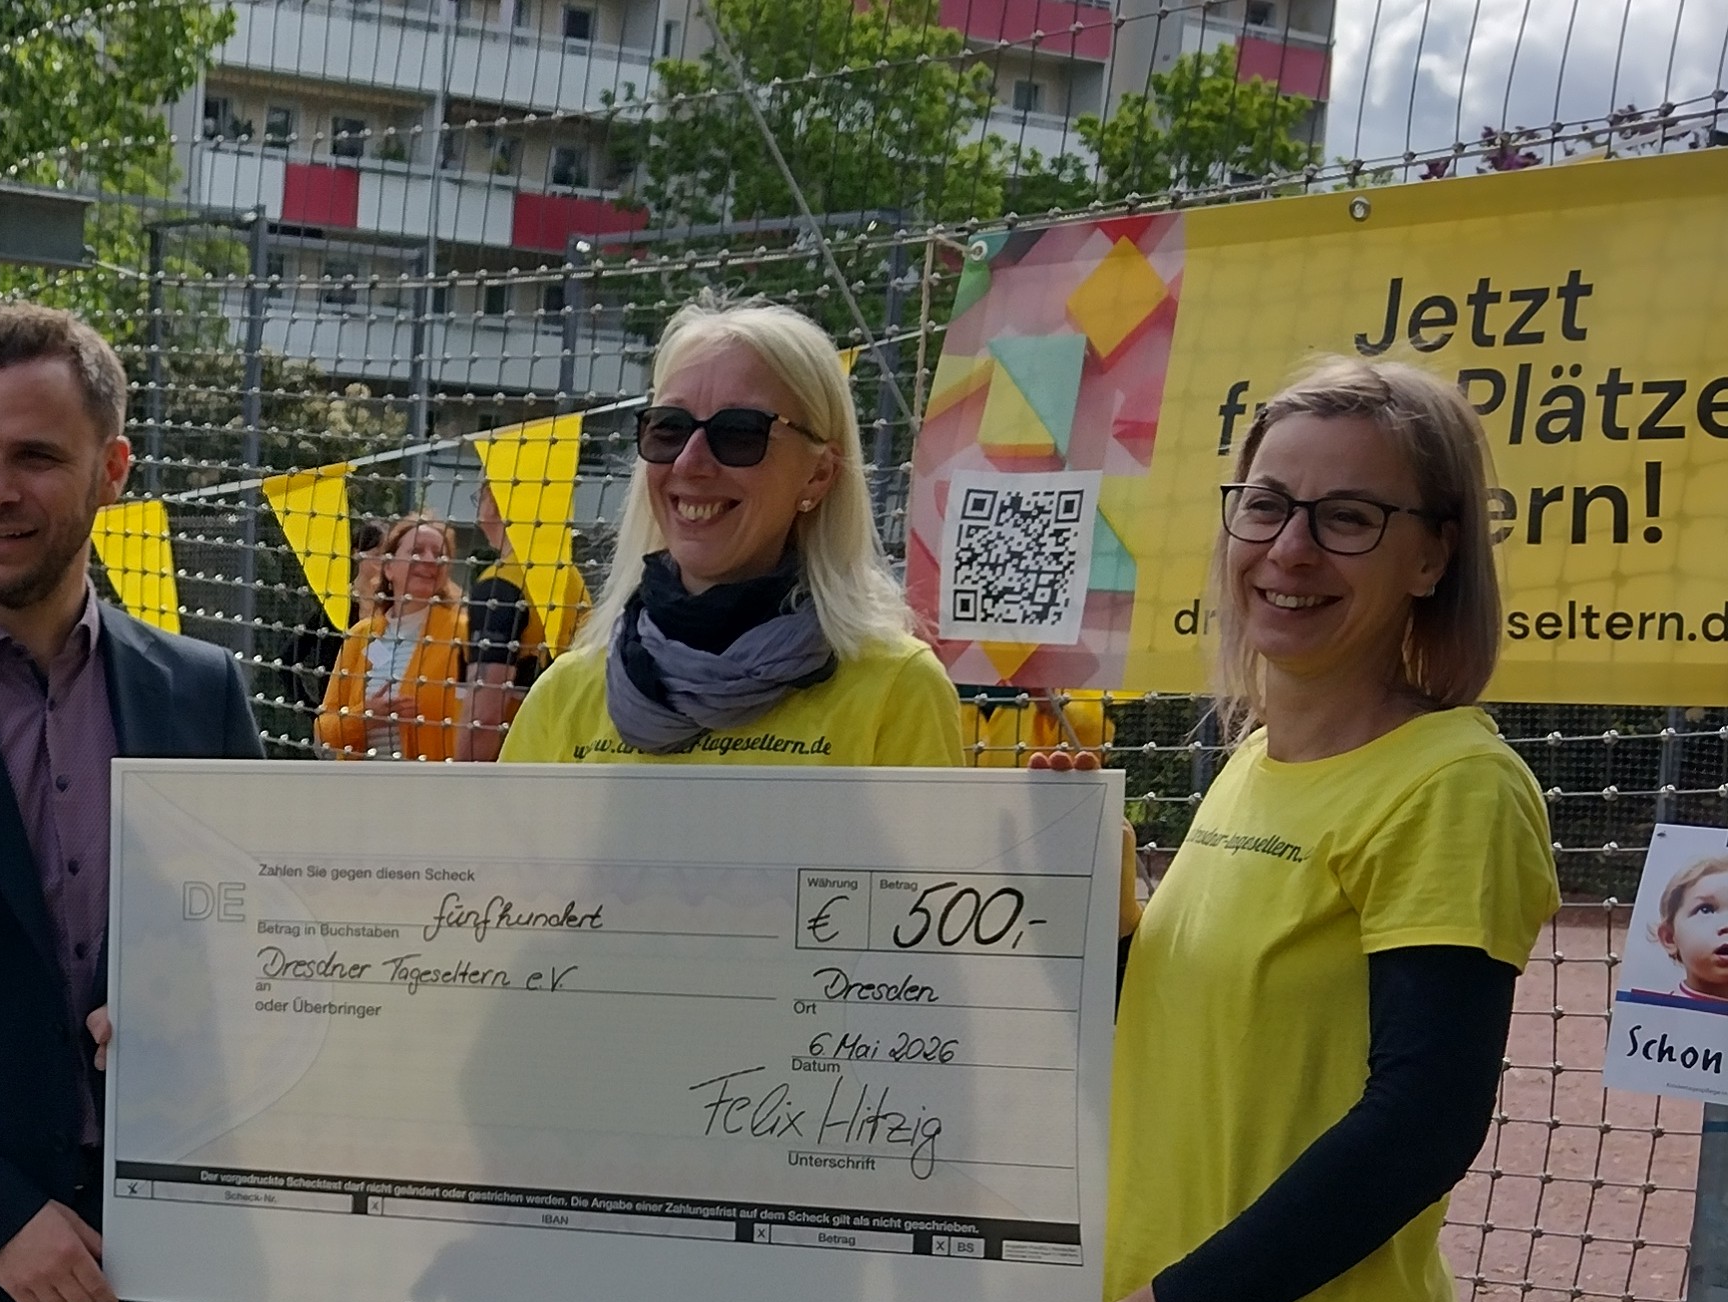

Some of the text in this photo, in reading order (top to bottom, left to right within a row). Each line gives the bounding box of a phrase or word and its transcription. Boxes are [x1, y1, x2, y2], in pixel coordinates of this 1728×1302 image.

[1353, 269, 1593, 356] Jetzt
[1486, 460, 1663, 547] ern!
[258, 863, 476, 883] Zahlen Sie gegen diesen Scheck
[806, 877, 859, 891] Währung
[879, 878, 919, 892] Betrag
[182, 880, 246, 923] DE
[806, 895, 850, 943] €
[257, 921, 400, 939] Betrag in Buchstaben
[256, 945, 372, 980] Dresdner
[382, 952, 510, 996] Tageseltern
[255, 981, 272, 992] an
[812, 966, 940, 1003] Dresden
[254, 997, 382, 1018] oder Überbringer
[793, 1002, 817, 1015] Ort
[833, 1032, 881, 1060] Mai
[888, 1031, 960, 1064] 2026
[1626, 1024, 1723, 1075] Schon
[791, 1057, 841, 1073] Datum
[689, 1065, 807, 1138] Felix
[787, 1152, 876, 1171] Unterschrift
[200, 1170, 980, 1234] Der vorgedruckte Schecktext darf nicht geändert oder gestrichen werden. Die Angabe einer Zahlungsfrist auf dem Scheck gilt als nicht geschrieben.
[541, 1214, 569, 1226] IBAN
[756, 1228, 766, 1239] X
[817, 1232, 857, 1247] Betrag
[935, 1240, 946, 1251] X
[957, 1241, 975, 1254] BS
